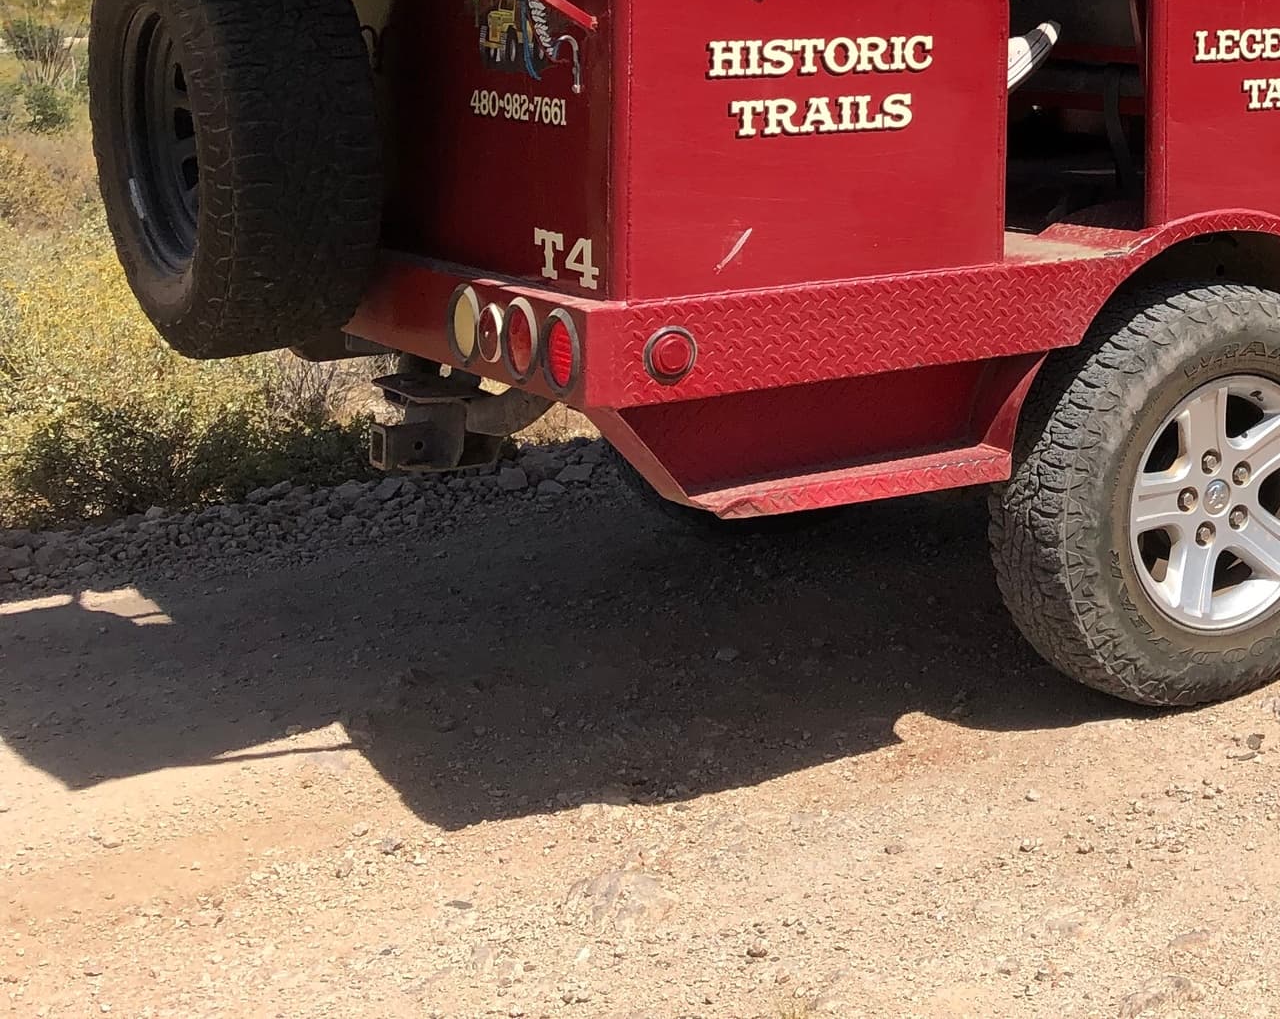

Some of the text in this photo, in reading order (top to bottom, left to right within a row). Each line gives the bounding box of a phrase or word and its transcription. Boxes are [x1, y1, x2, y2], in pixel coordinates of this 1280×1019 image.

[706, 35, 934, 80] HISTORIC
[469, 90, 568, 127] 480-982-7661
[728, 93, 914, 140] TRAILS
[533, 227, 600, 290] T4
